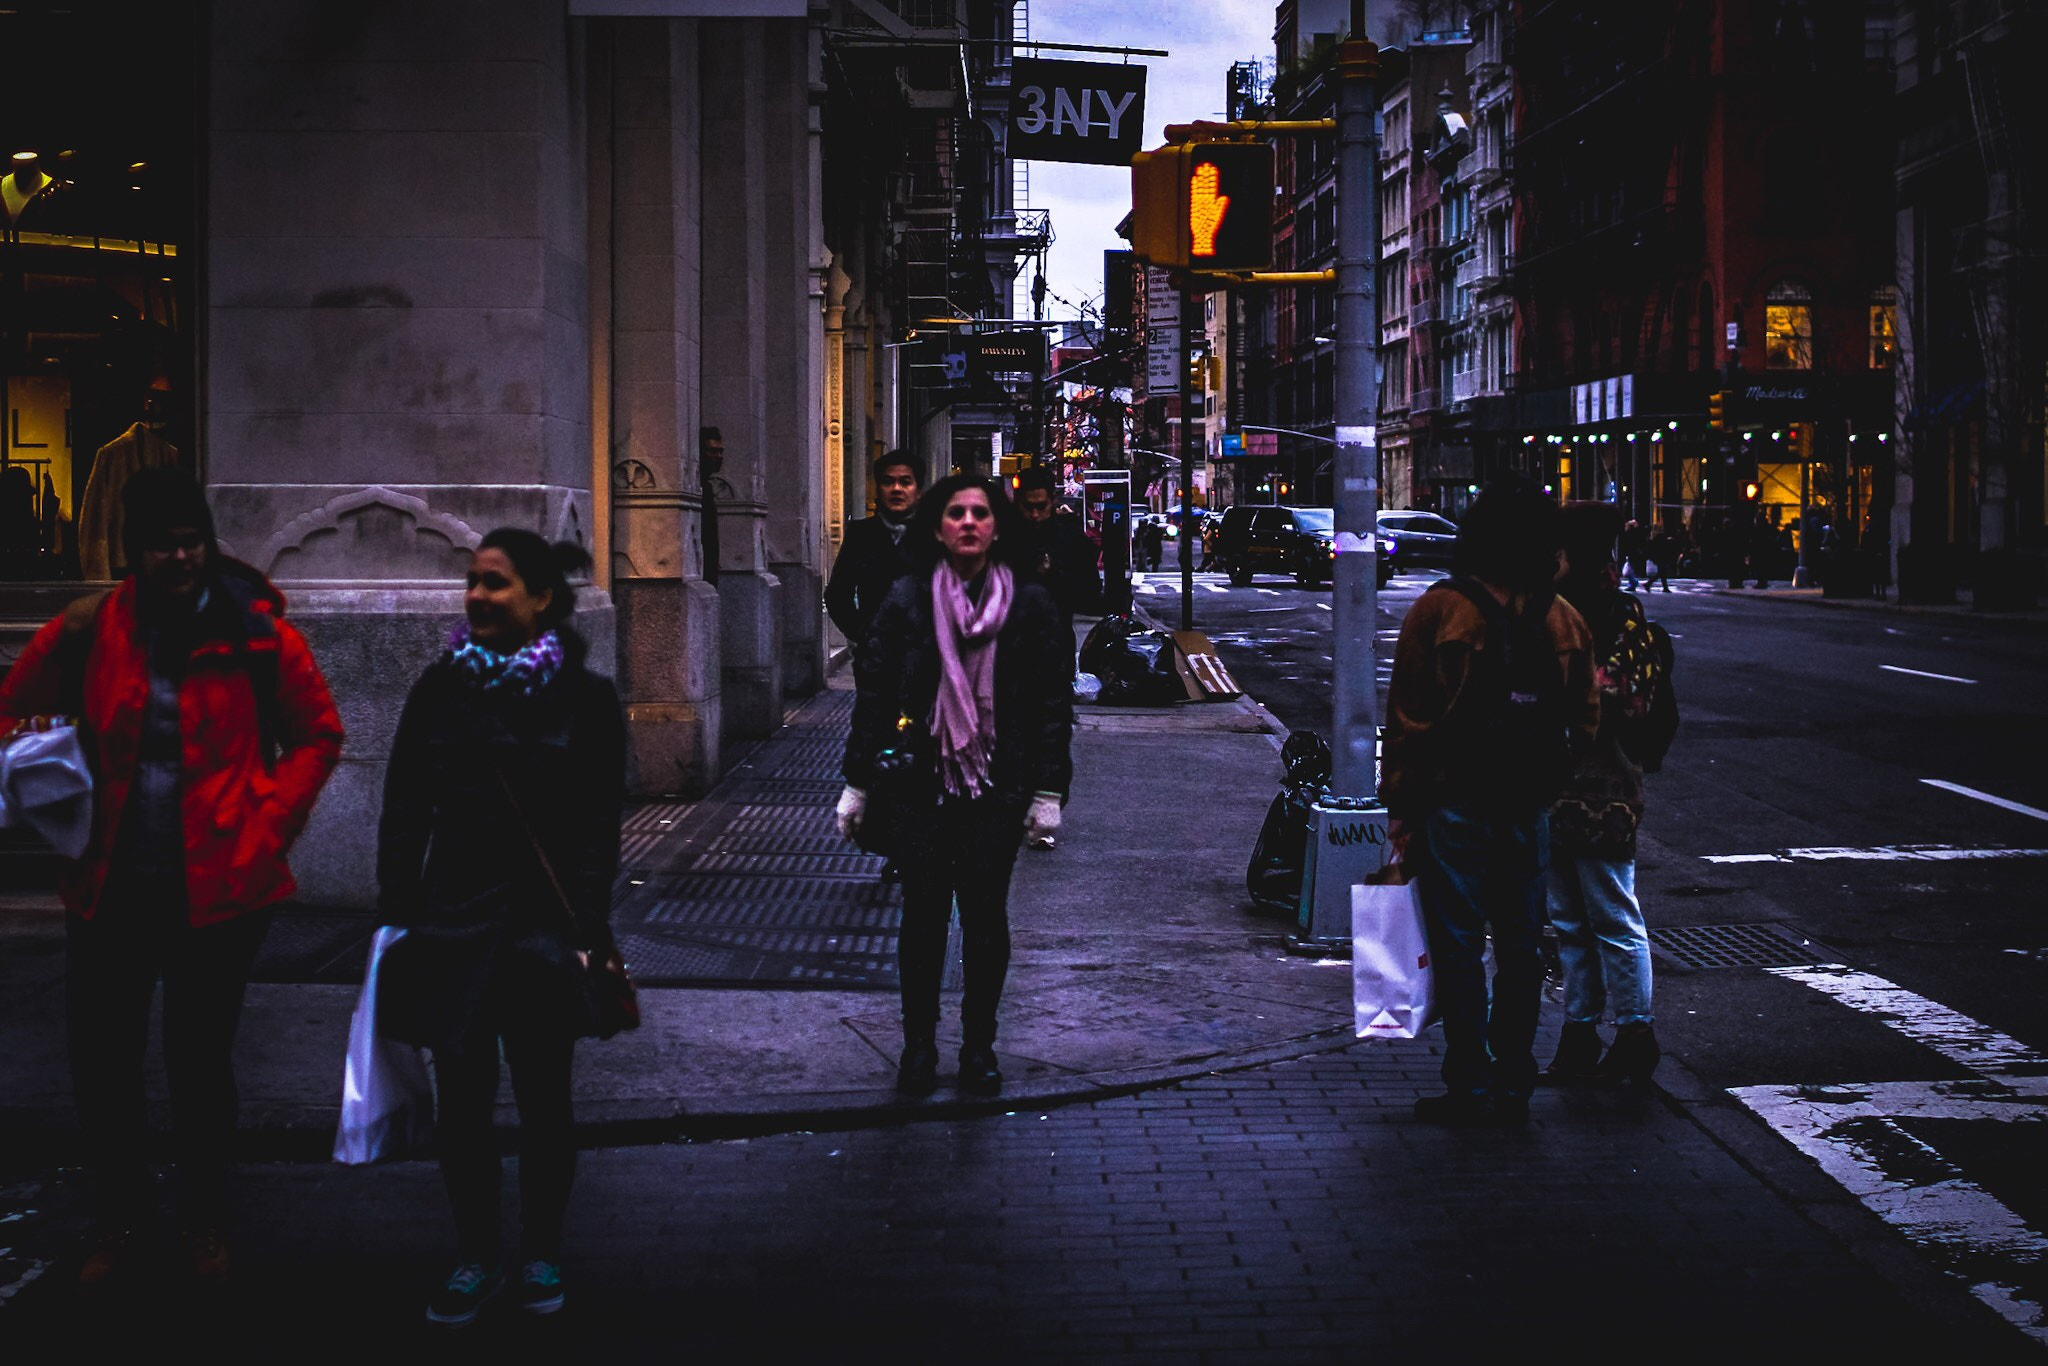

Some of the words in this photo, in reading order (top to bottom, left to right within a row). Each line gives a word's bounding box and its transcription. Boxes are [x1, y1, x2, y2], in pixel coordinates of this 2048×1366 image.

[1017, 86, 1137, 139] 3NY
[1150, 330, 1156, 344] 2
[1113, 512, 1121, 524] P
